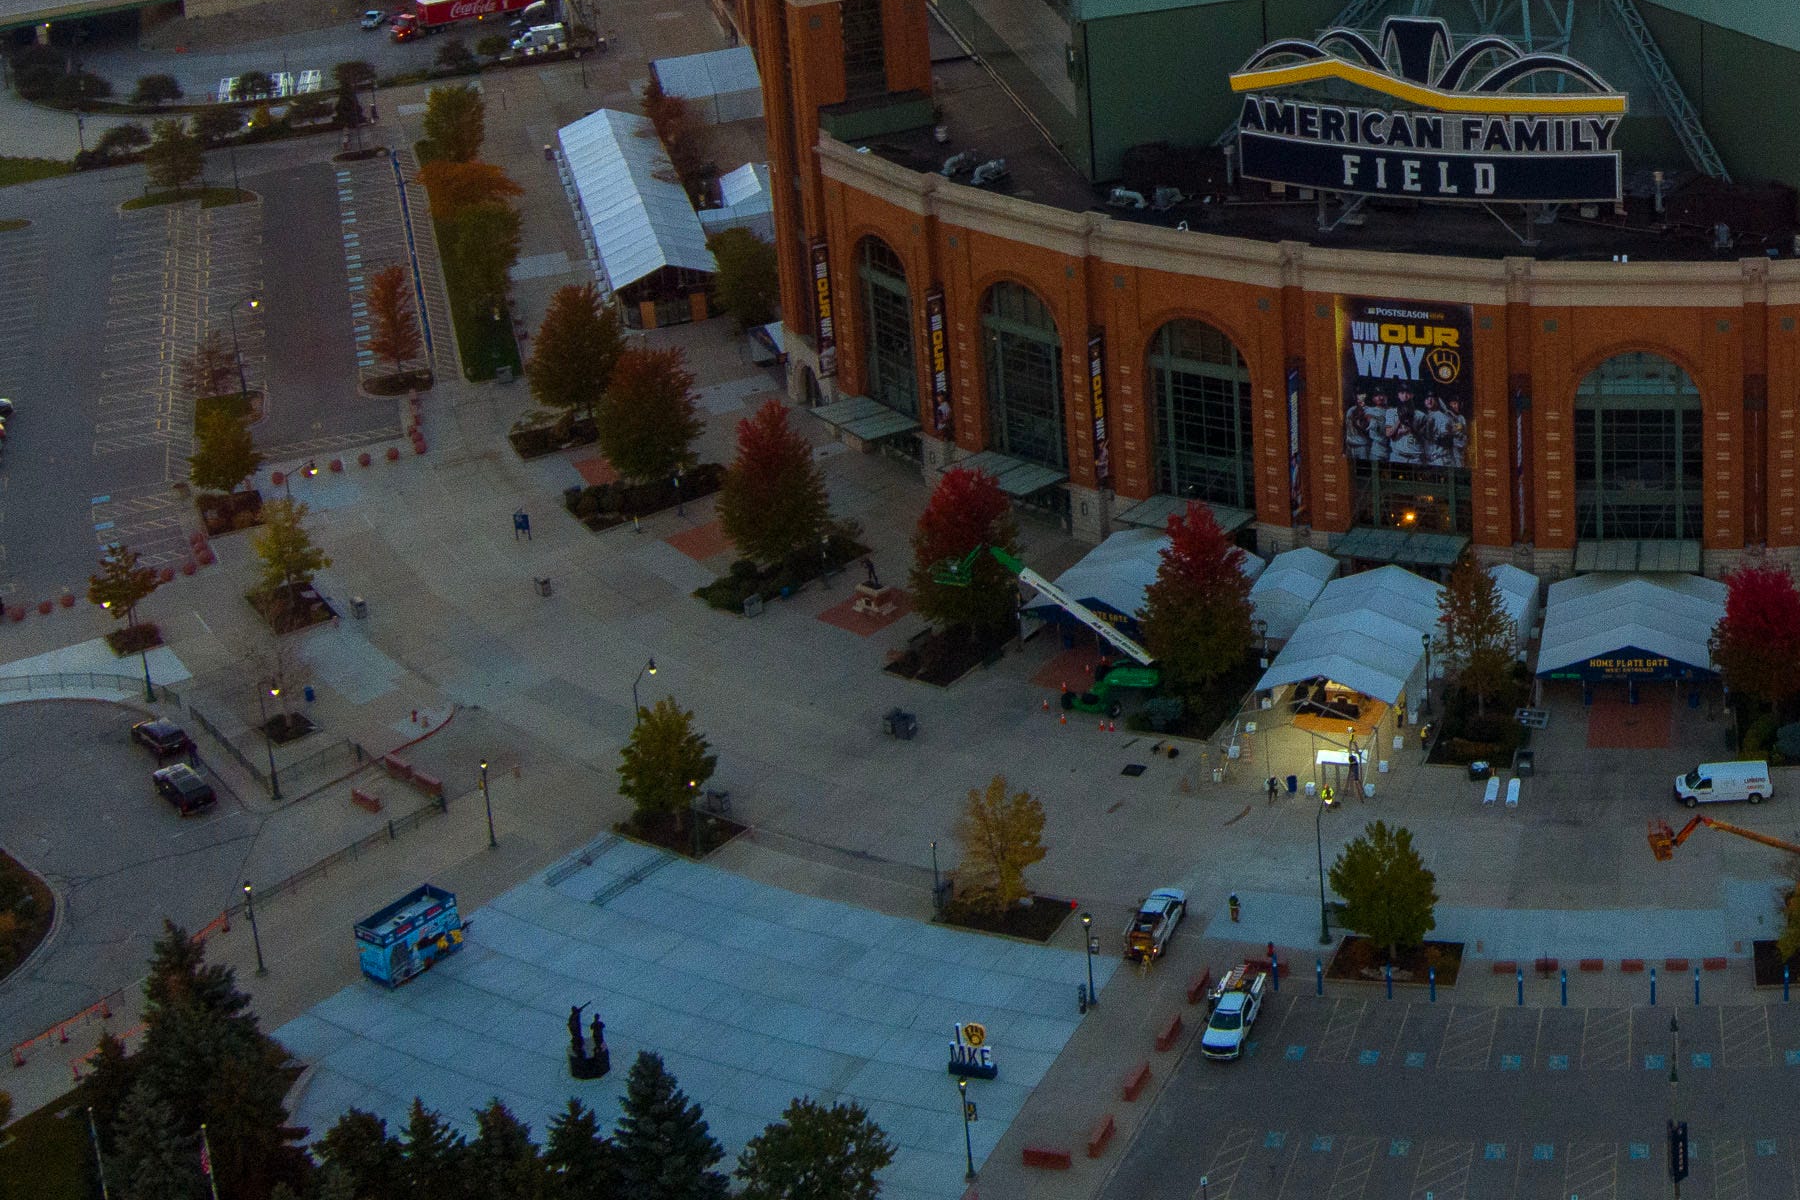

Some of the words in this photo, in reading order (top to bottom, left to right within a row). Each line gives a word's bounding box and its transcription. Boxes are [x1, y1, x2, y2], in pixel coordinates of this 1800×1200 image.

[1241, 97, 1445, 149] AMERICAN
[1461, 115, 1622, 152] FAMILY
[1342, 154, 1496, 195] FIELD
[1375, 307, 1429, 319] POSTSEASON
[1352, 320, 1379, 342] WIN
[1380, 323, 1460, 347] OUR
[1352, 343, 1426, 381] WAY
[1589, 659, 1614, 668] HOME
[1616, 659, 1644, 668] PLATE
[1646, 658, 1670, 667] GATE
[949, 1041, 993, 1069] MKE
